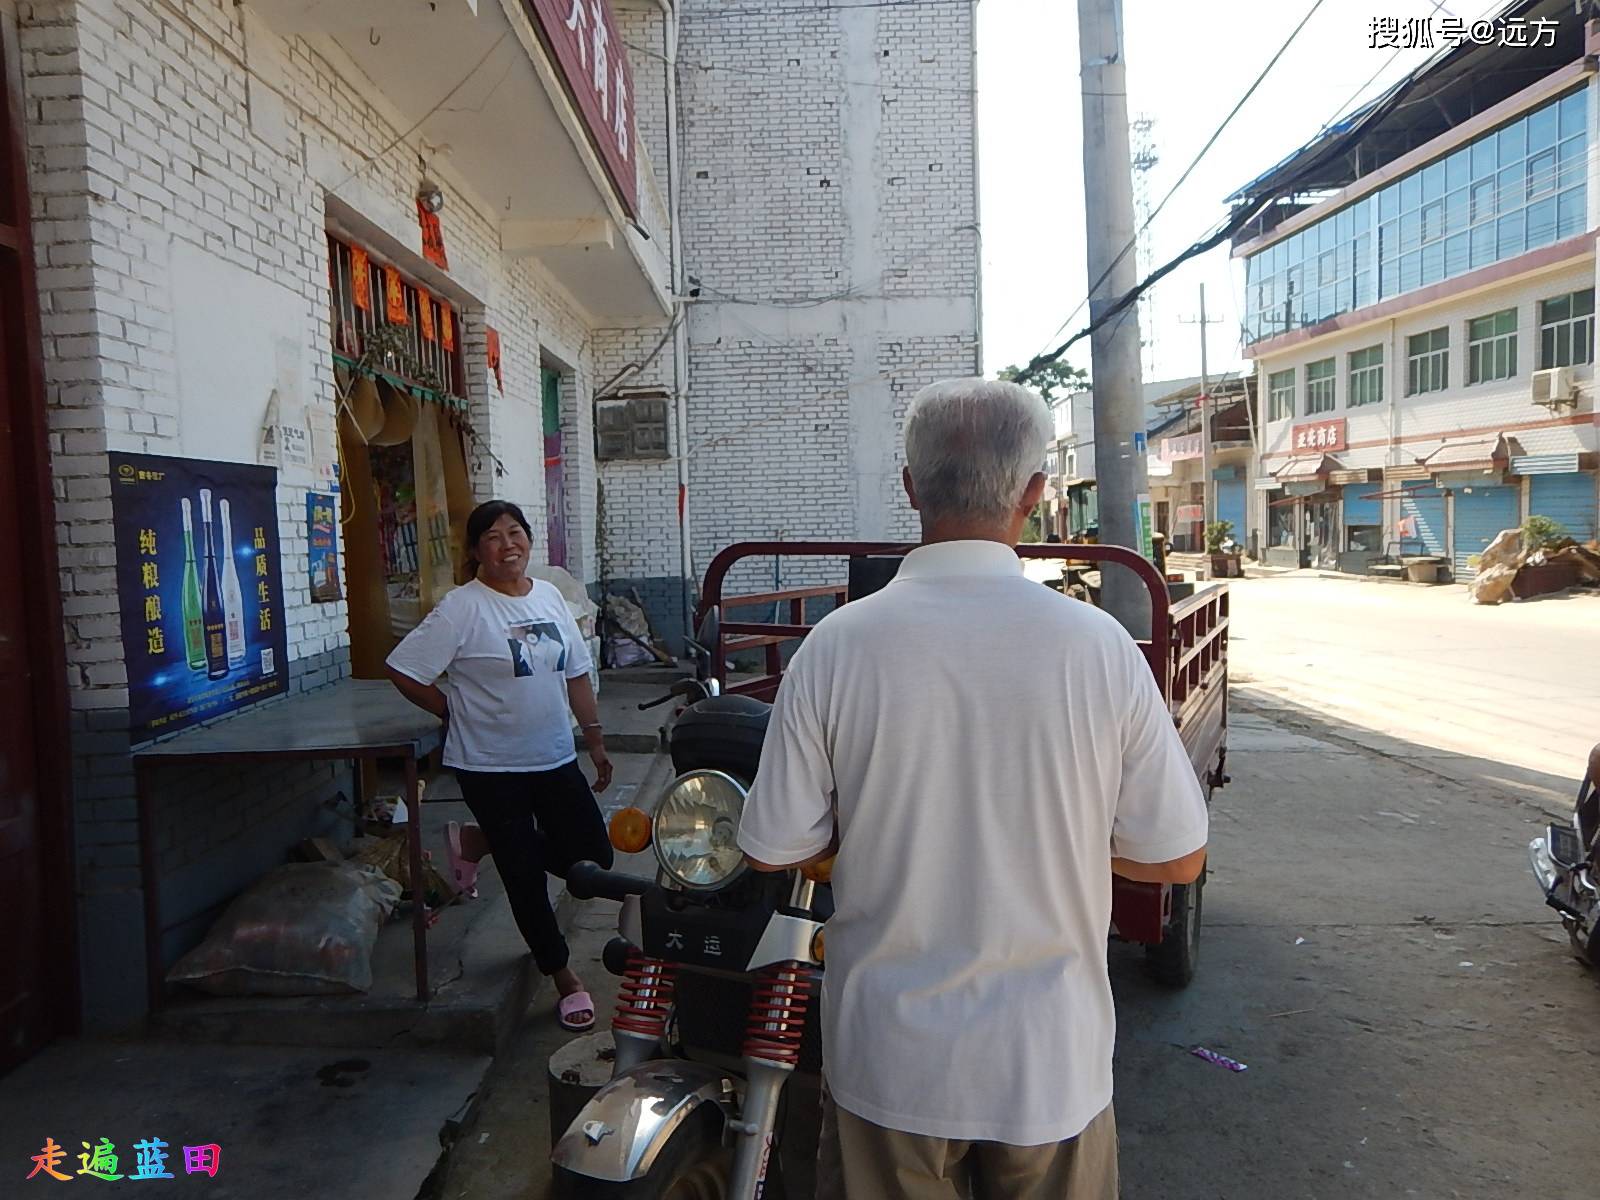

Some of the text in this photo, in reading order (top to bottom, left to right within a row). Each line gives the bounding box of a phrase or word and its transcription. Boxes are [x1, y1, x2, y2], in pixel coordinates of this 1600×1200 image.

[139, 528, 165, 655] 纯粮酿造
[254, 527, 272, 632] 品质生活
[665, 929, 723, 956] 大运
